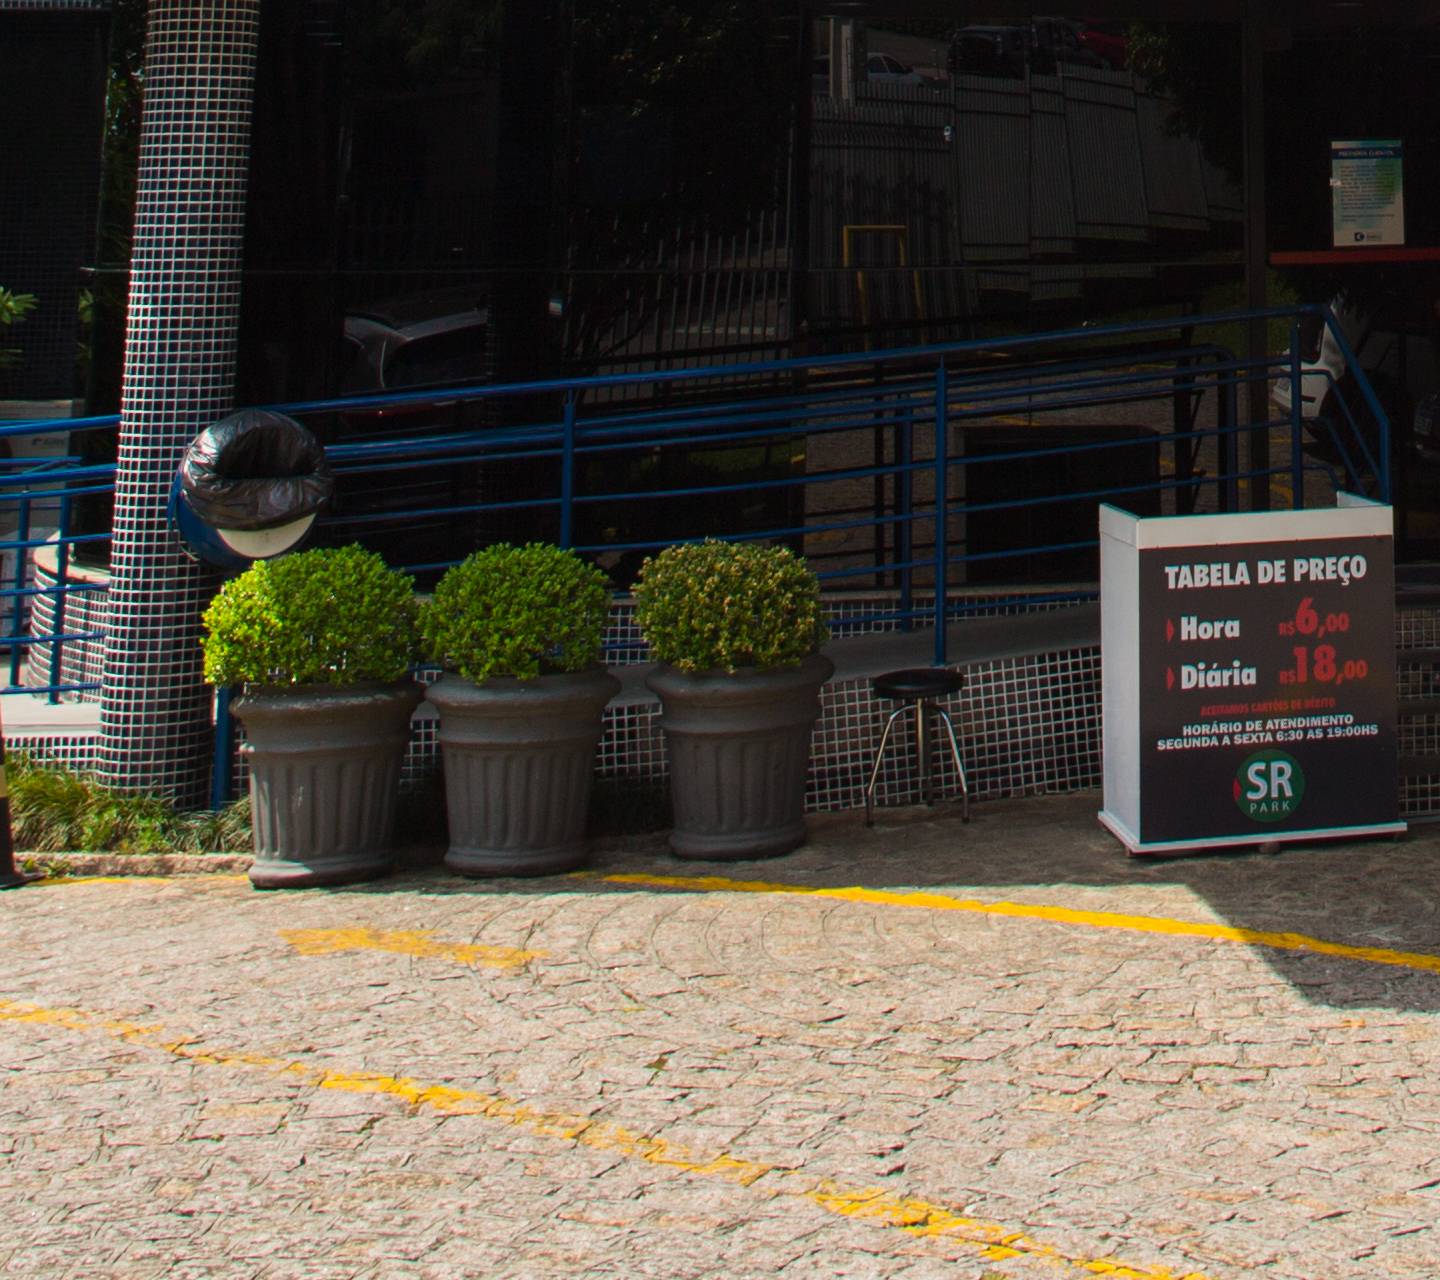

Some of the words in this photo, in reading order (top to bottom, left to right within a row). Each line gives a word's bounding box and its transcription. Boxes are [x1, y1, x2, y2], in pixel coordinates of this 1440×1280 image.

[1165, 561, 1250, 589] TABELA
[1257, 559, 1286, 584] DE
[1293, 555, 1367, 586] PREÇO
[1180, 615, 1240, 641] Hora
[1180, 659, 1257, 689] Diária
[1157, 735, 1219, 751] SEGUNDA
[1221, 735, 1231, 746] A
[1233, 731, 1273, 746] SEXTA
[1276, 730, 1303, 742] 6:30
[1326, 724, 1379, 738] 19:00HS
[1182, 720, 1243, 737] HORÁRIO
[1245, 720, 1263, 732] DE
[1265, 714, 1354, 731] ATENDIMENTO
[1246, 759, 1294, 801] SR
[1250, 801, 1291, 814] PARK
